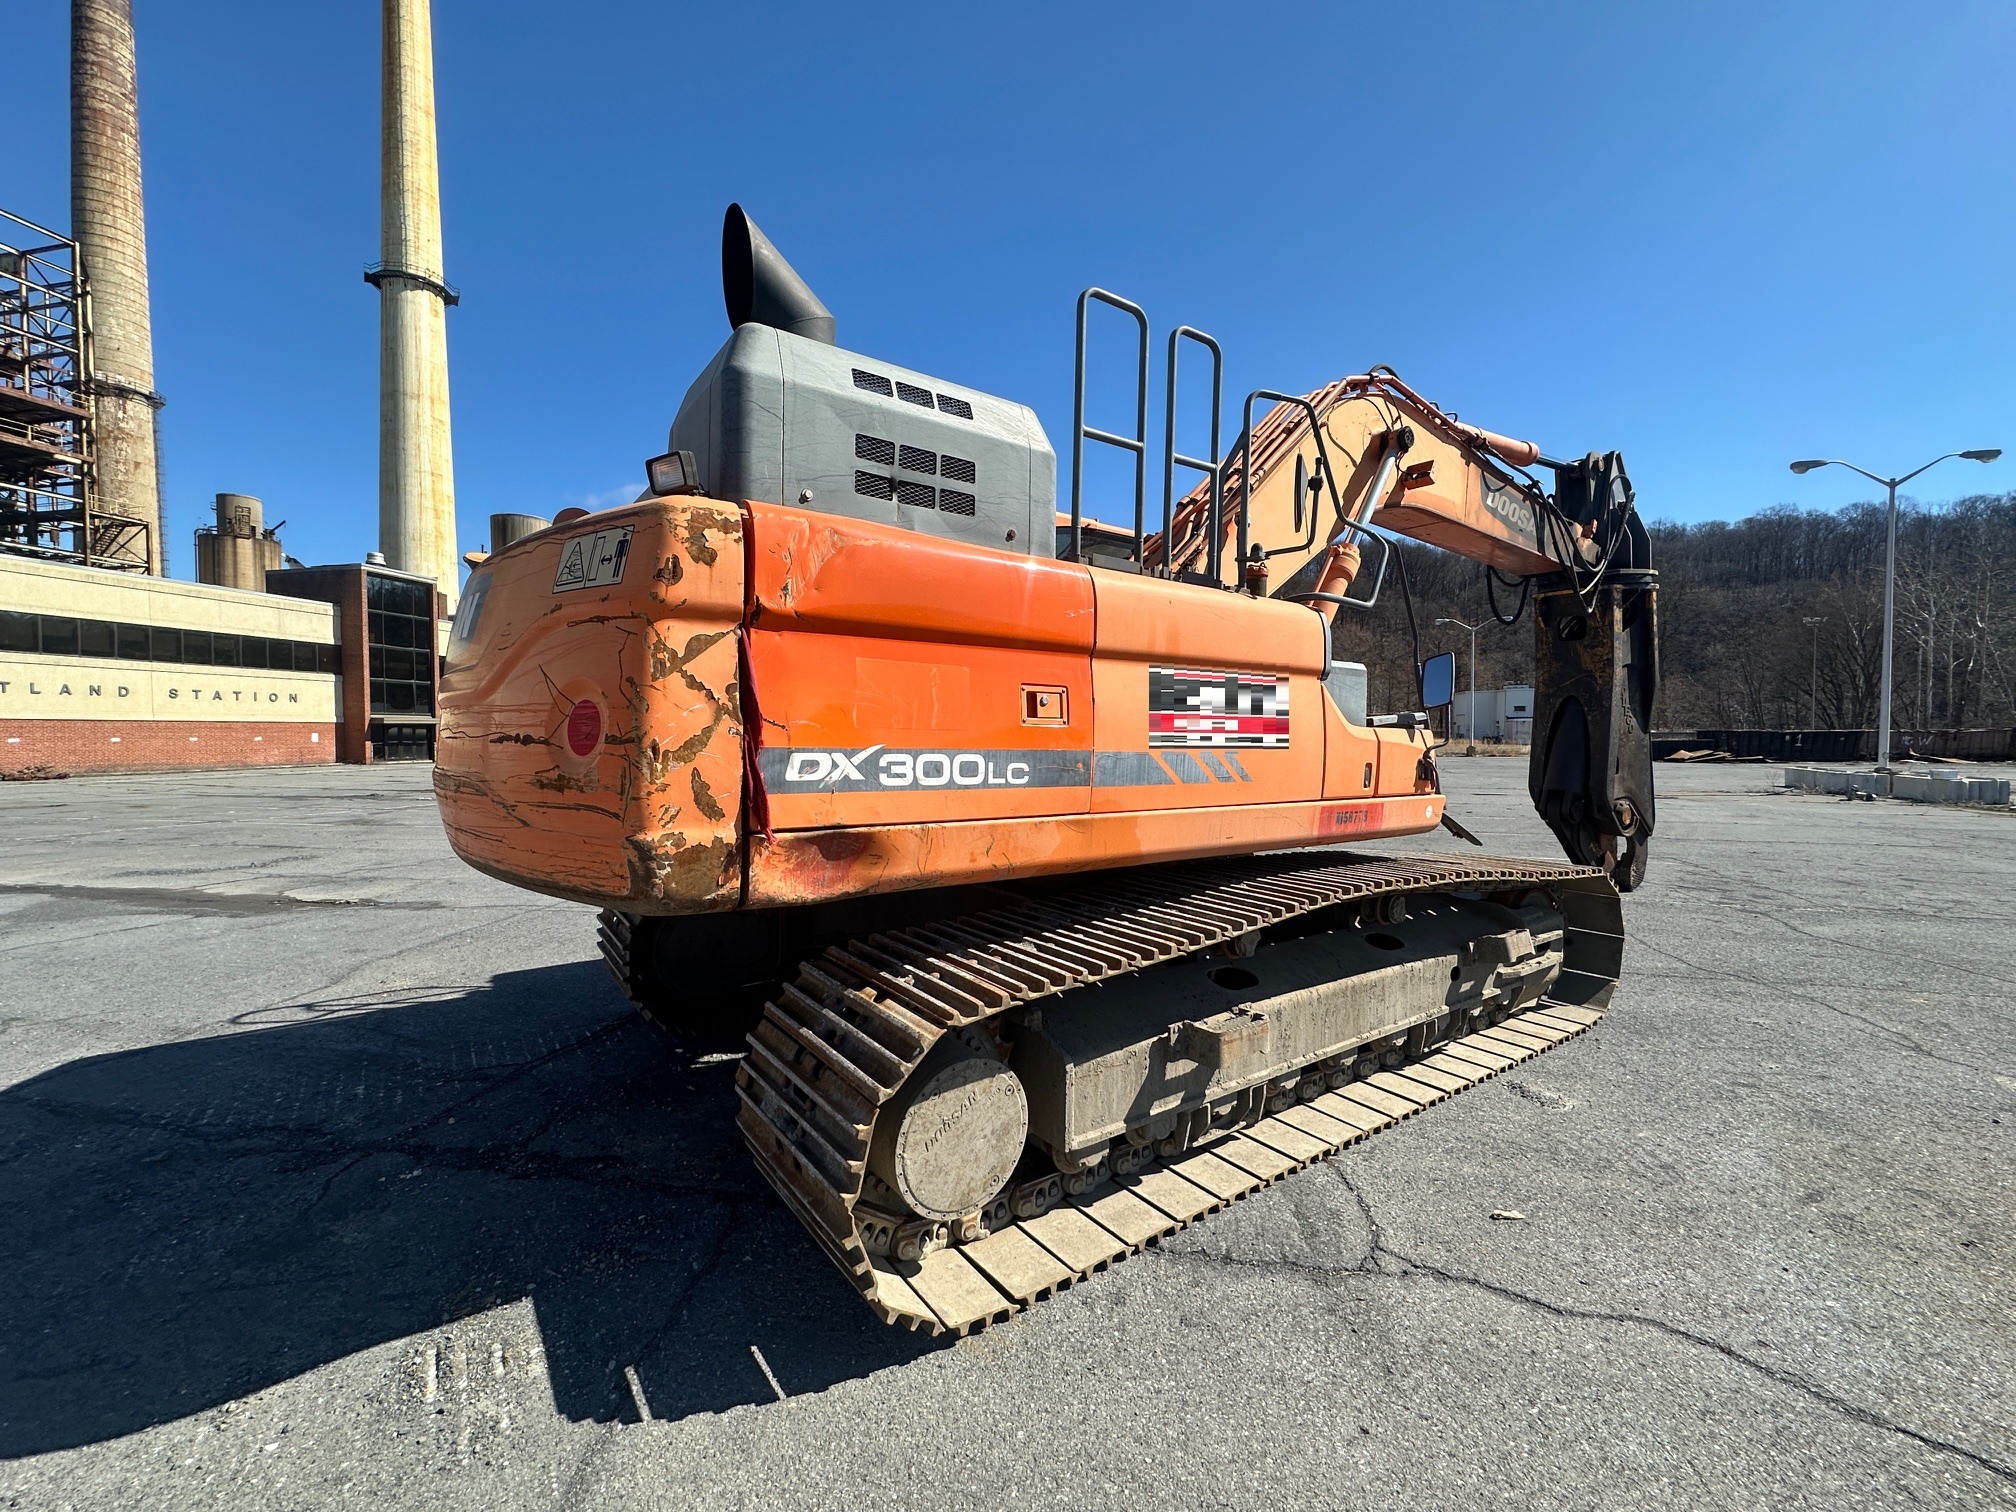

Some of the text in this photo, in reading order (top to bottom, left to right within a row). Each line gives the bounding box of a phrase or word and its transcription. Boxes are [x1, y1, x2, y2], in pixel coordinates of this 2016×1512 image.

[1486, 492, 1537, 534] DOOSA
[0, 681, 299, 703] TLAND STATION
